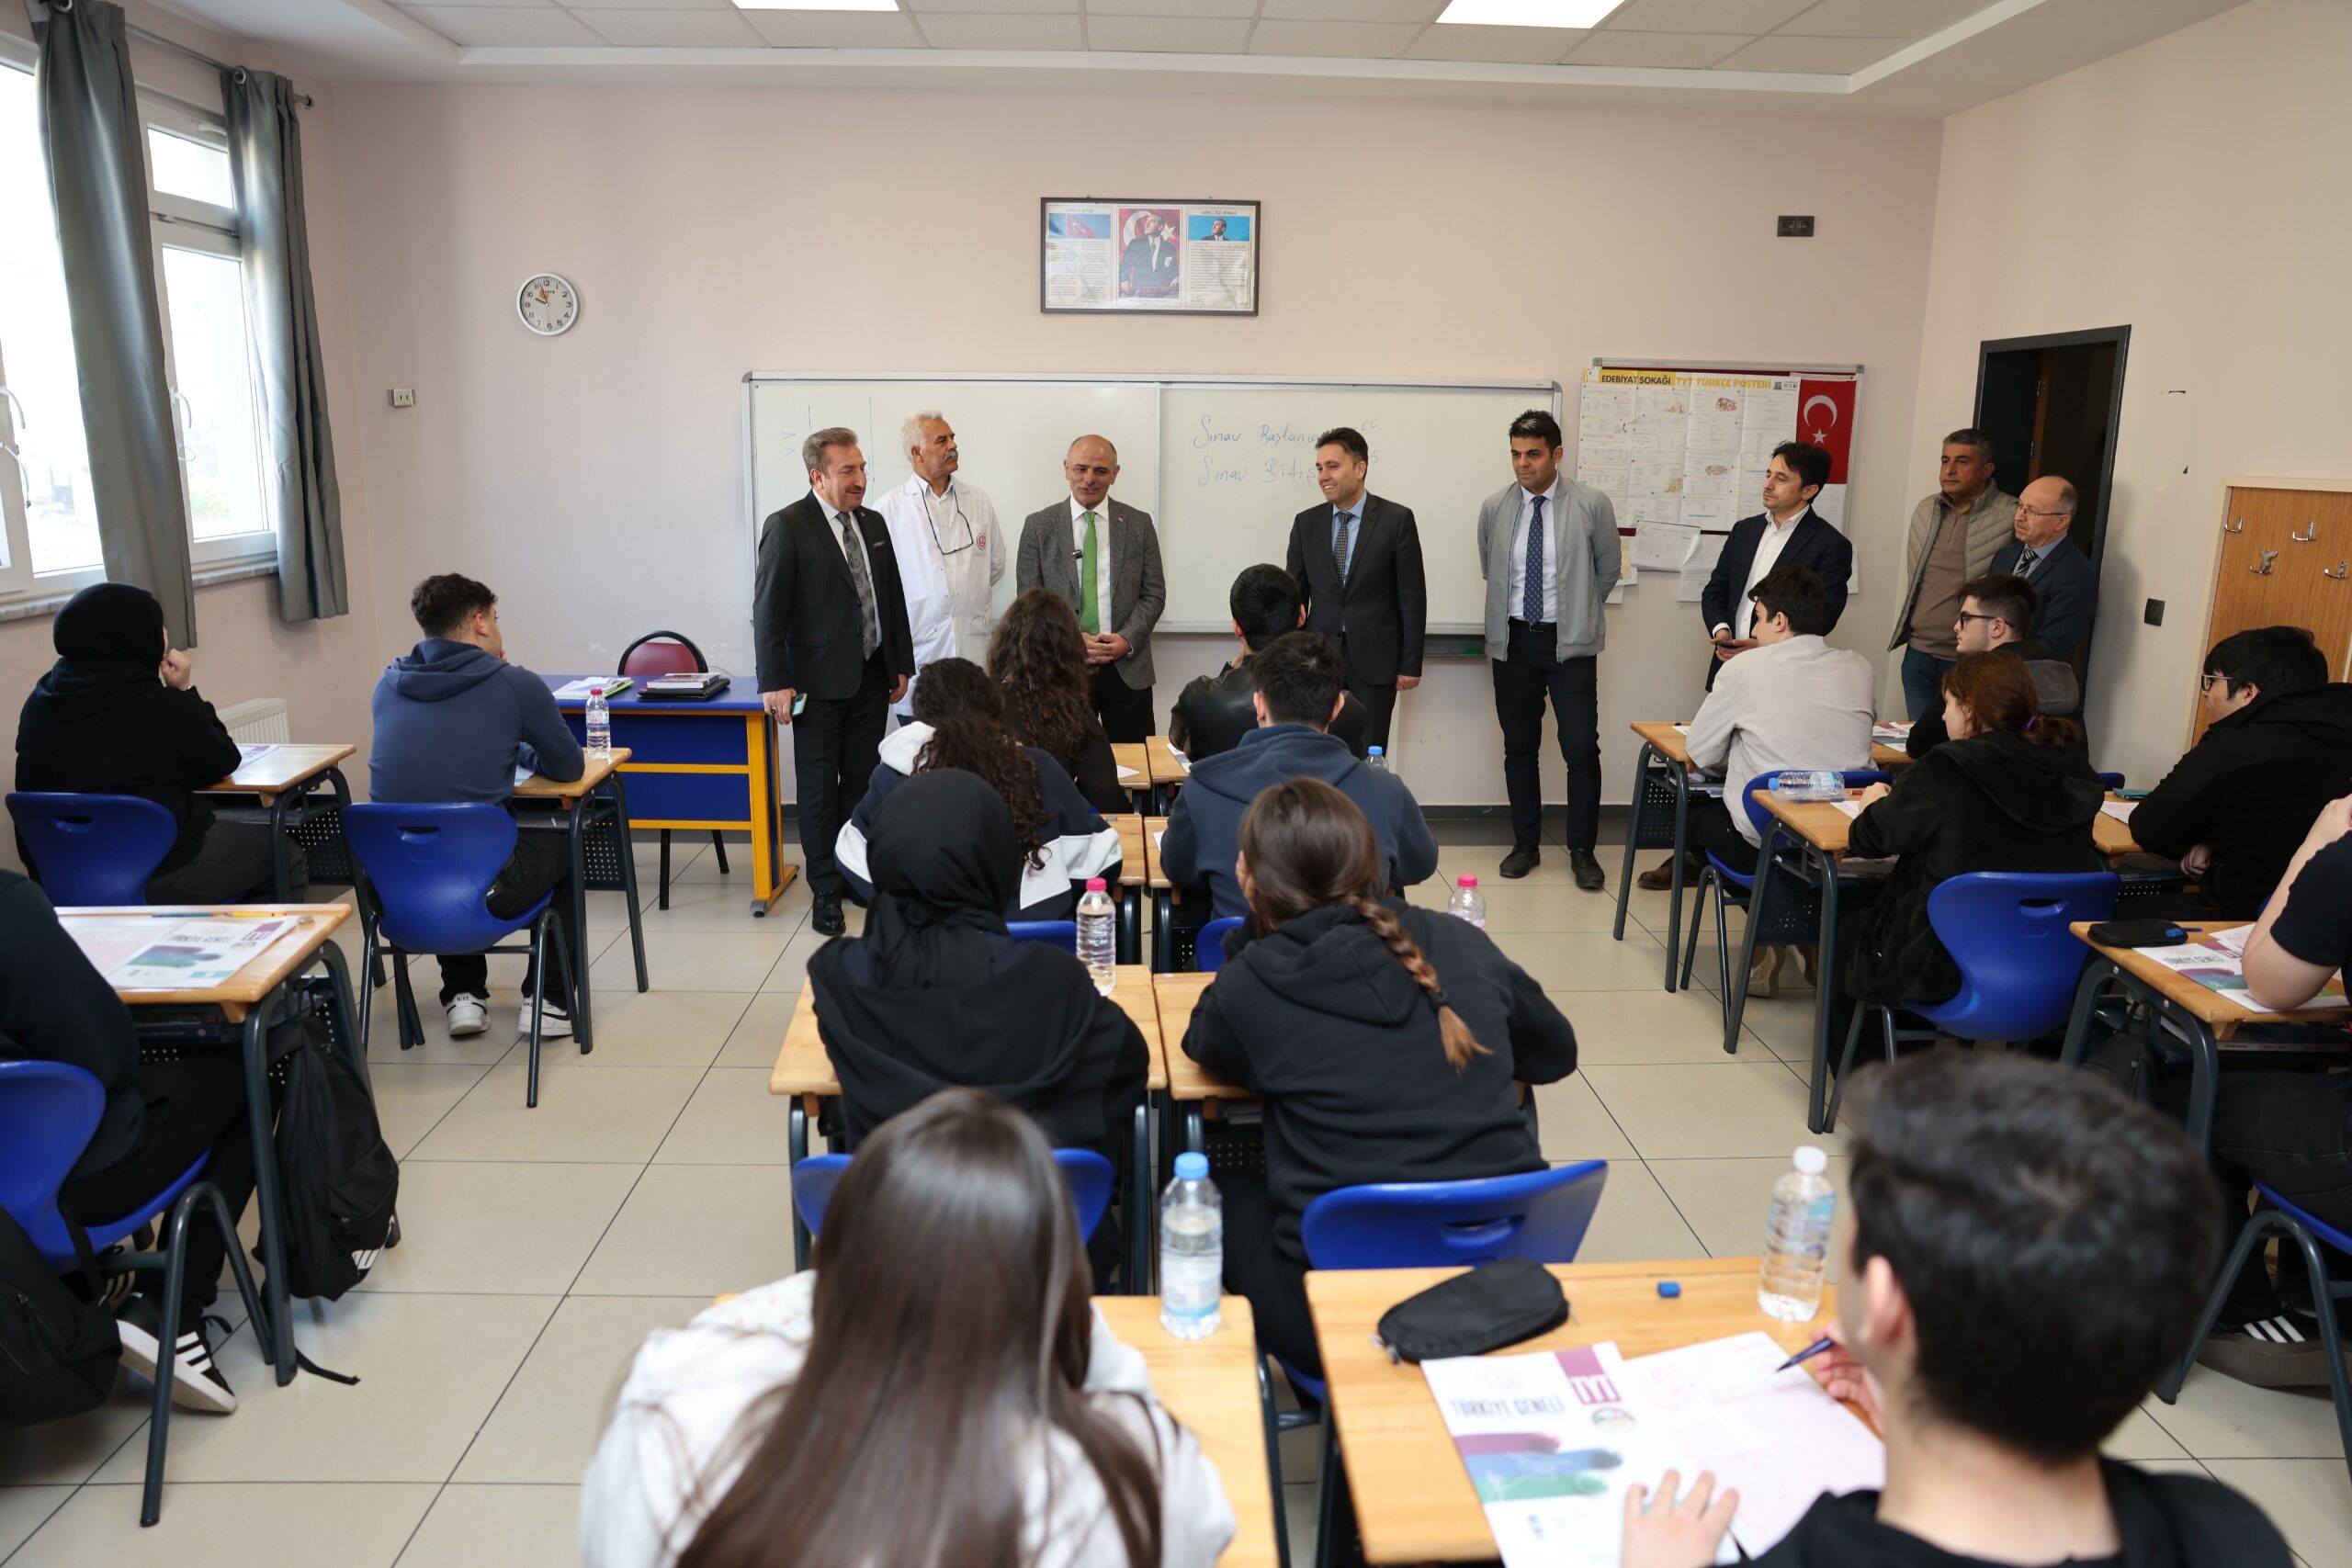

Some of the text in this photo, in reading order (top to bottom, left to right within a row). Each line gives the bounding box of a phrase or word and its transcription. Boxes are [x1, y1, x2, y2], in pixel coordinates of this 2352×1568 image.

[1601, 375, 1638, 384] EDEBİYAT
[1639, 375, 1671, 385] SOKAĞI
[1696, 376, 1732, 389] TÜRKÇE
[1733, 378, 1771, 389] POSTERİ
[1193, 414, 1241, 449] Sınav
